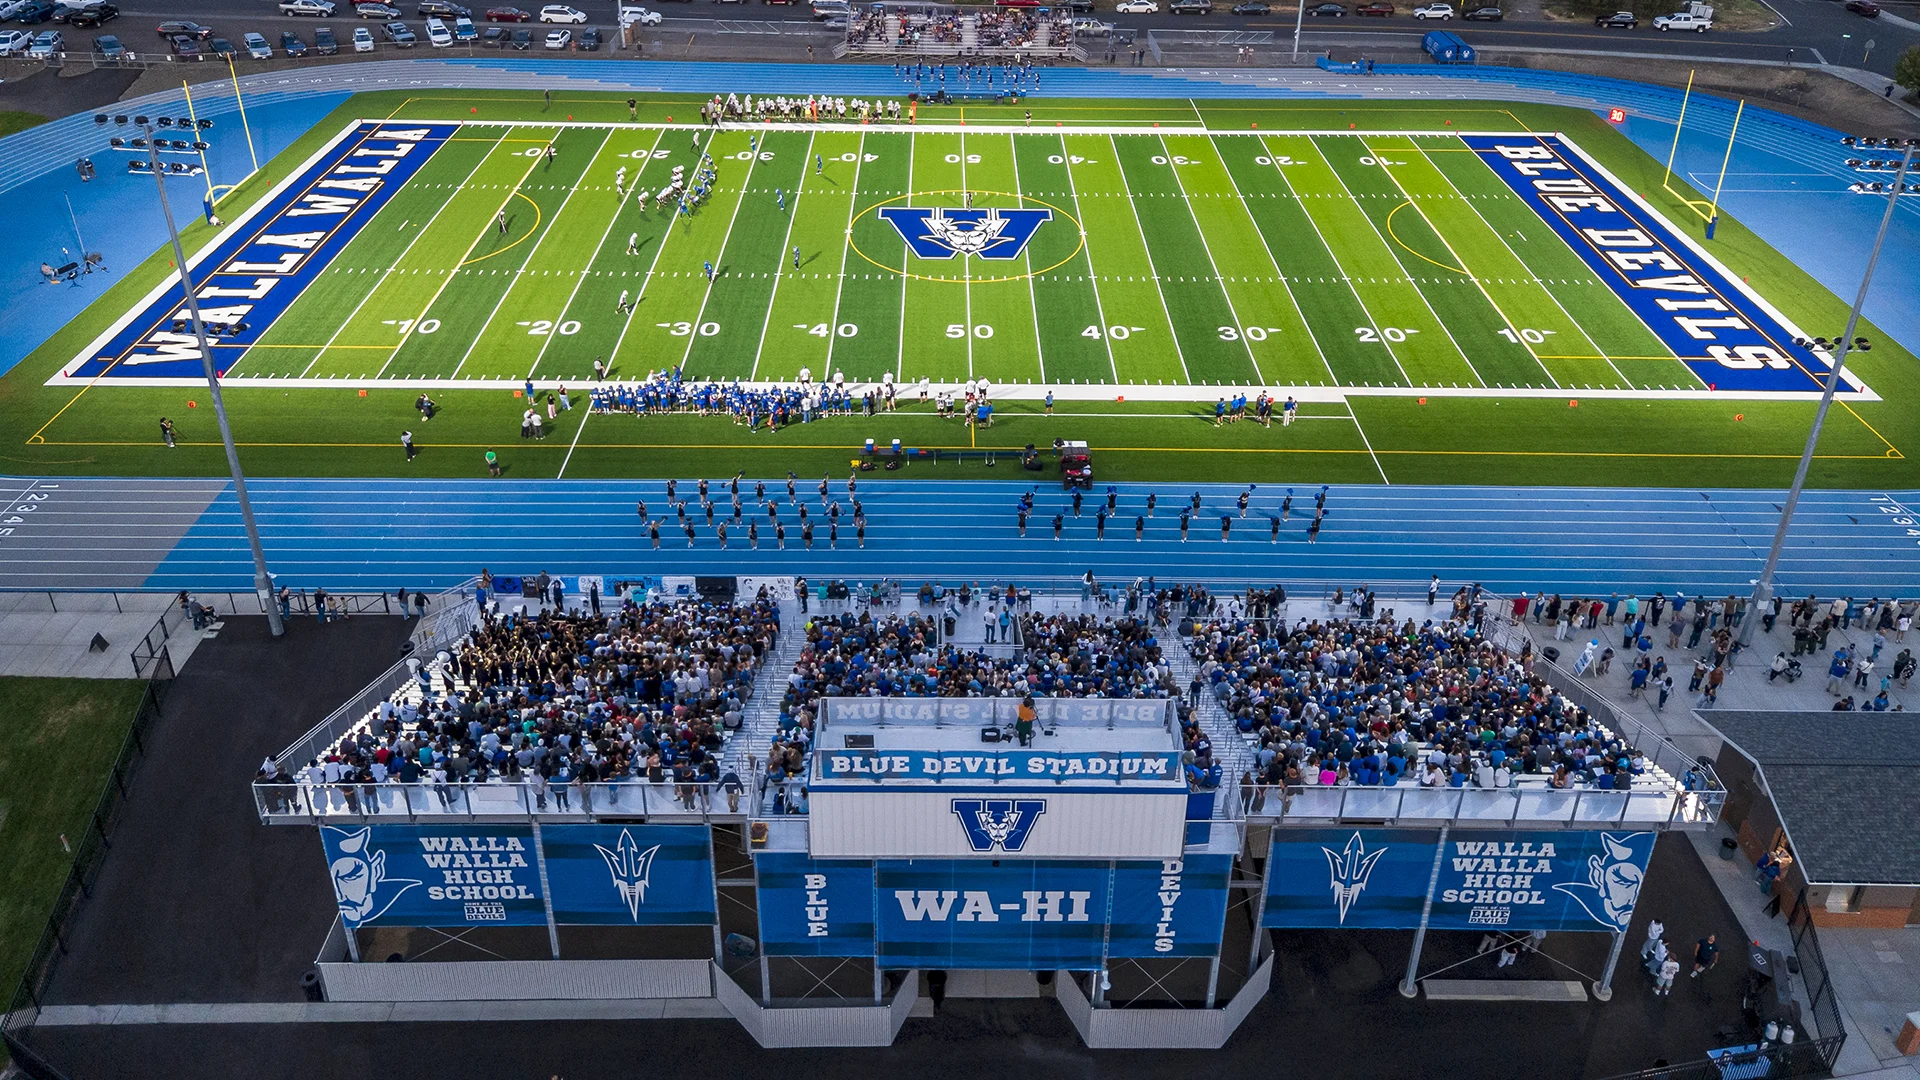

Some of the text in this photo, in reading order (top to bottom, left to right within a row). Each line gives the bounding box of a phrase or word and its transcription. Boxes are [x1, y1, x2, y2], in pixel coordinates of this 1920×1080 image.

[1611, 109, 1624, 122] 30
[635, 150, 671, 159] 20
[739, 151, 776, 161] 30
[841, 152, 879, 162] 40
[945, 154, 982, 164] 50
[1048, 155, 1086, 164] 40
[1151, 156, 1188, 165] 30
[1255, 156, 1294, 165] 20
[1359, 156, 1395, 166] 10
[123, 129, 431, 365] WALLA WALLA
[1494, 145, 1792, 370] BLUE DEVILS
[398, 319, 441, 334] 10
[529, 320, 581, 335] 20
[670, 321, 720, 336] 30
[808, 322, 858, 338] 40
[945, 324, 994, 339] 50
[1081, 324, 1130, 340] 40
[1218, 326, 1268, 341] 30
[1355, 327, 1407, 342] 20
[1498, 328, 1545, 344] 10
[831, 756, 1168, 775] BLUE DEVIL STADIUM
[419, 837, 525, 852] WALLA
[1456, 842, 1556, 856] WALLA
[422, 854, 528, 868] WALLA
[1452, 858, 1552, 873] WALLA
[442, 870, 514, 884] HIGH
[1463, 874, 1534, 888] HIGH
[428, 886, 534, 900] SCHOOL
[1442, 890, 1545, 904] SCHOOL
[804, 874, 828, 937] BLUE
[895, 891, 1091, 922] WA-HI
[1154, 860, 1184, 952] DEVILS
